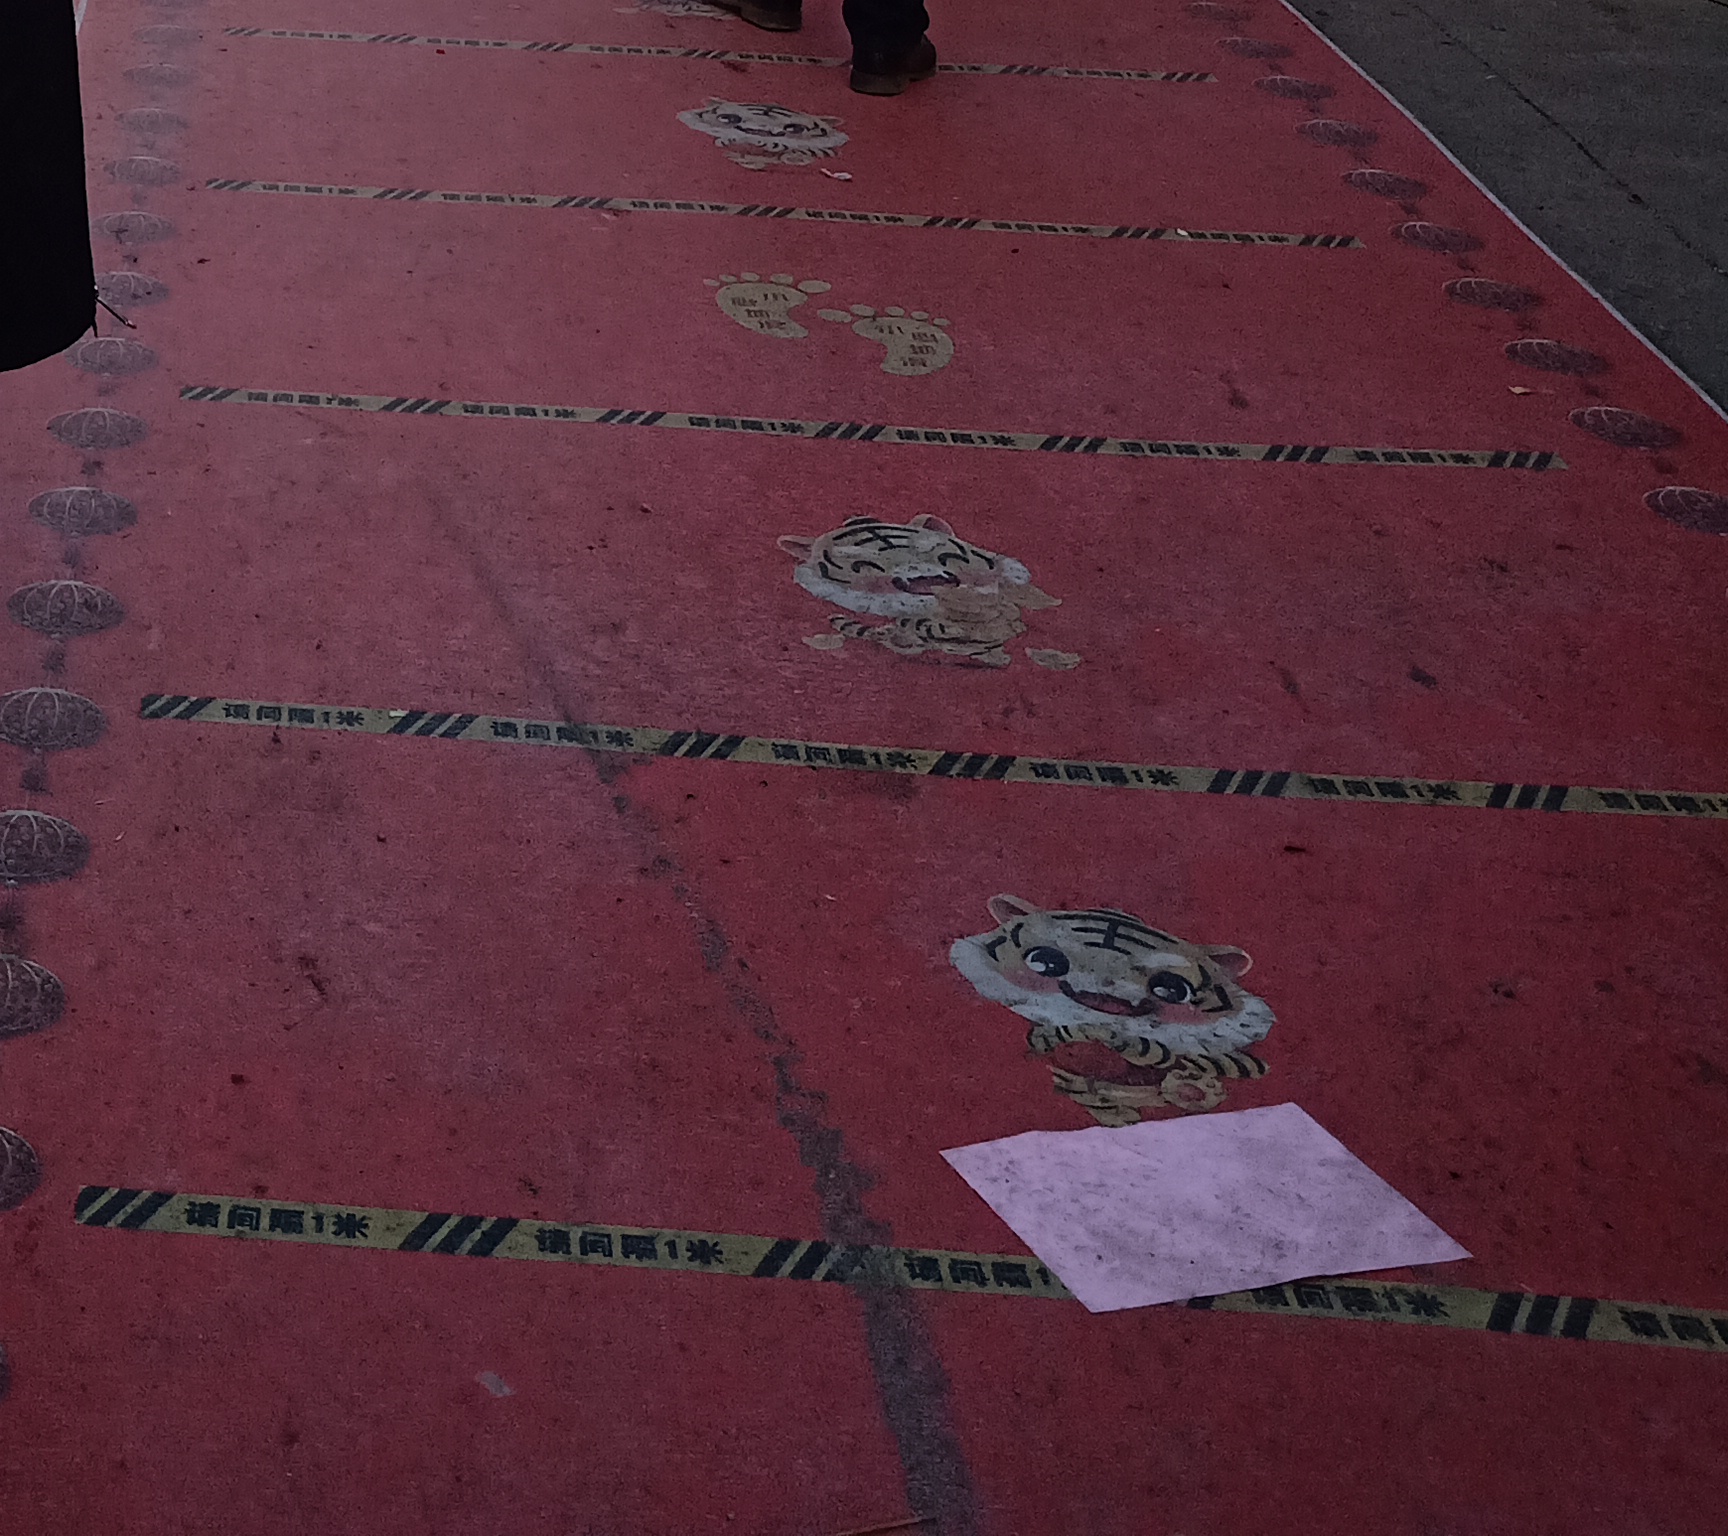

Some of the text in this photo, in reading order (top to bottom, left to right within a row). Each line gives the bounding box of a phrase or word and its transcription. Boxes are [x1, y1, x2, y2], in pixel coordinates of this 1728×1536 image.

[185, 1201, 370, 1239] 请间隔1米
[535, 1228, 723, 1265] 请间隔1米
[904, 1255, 1052, 1289] 请间隔1
